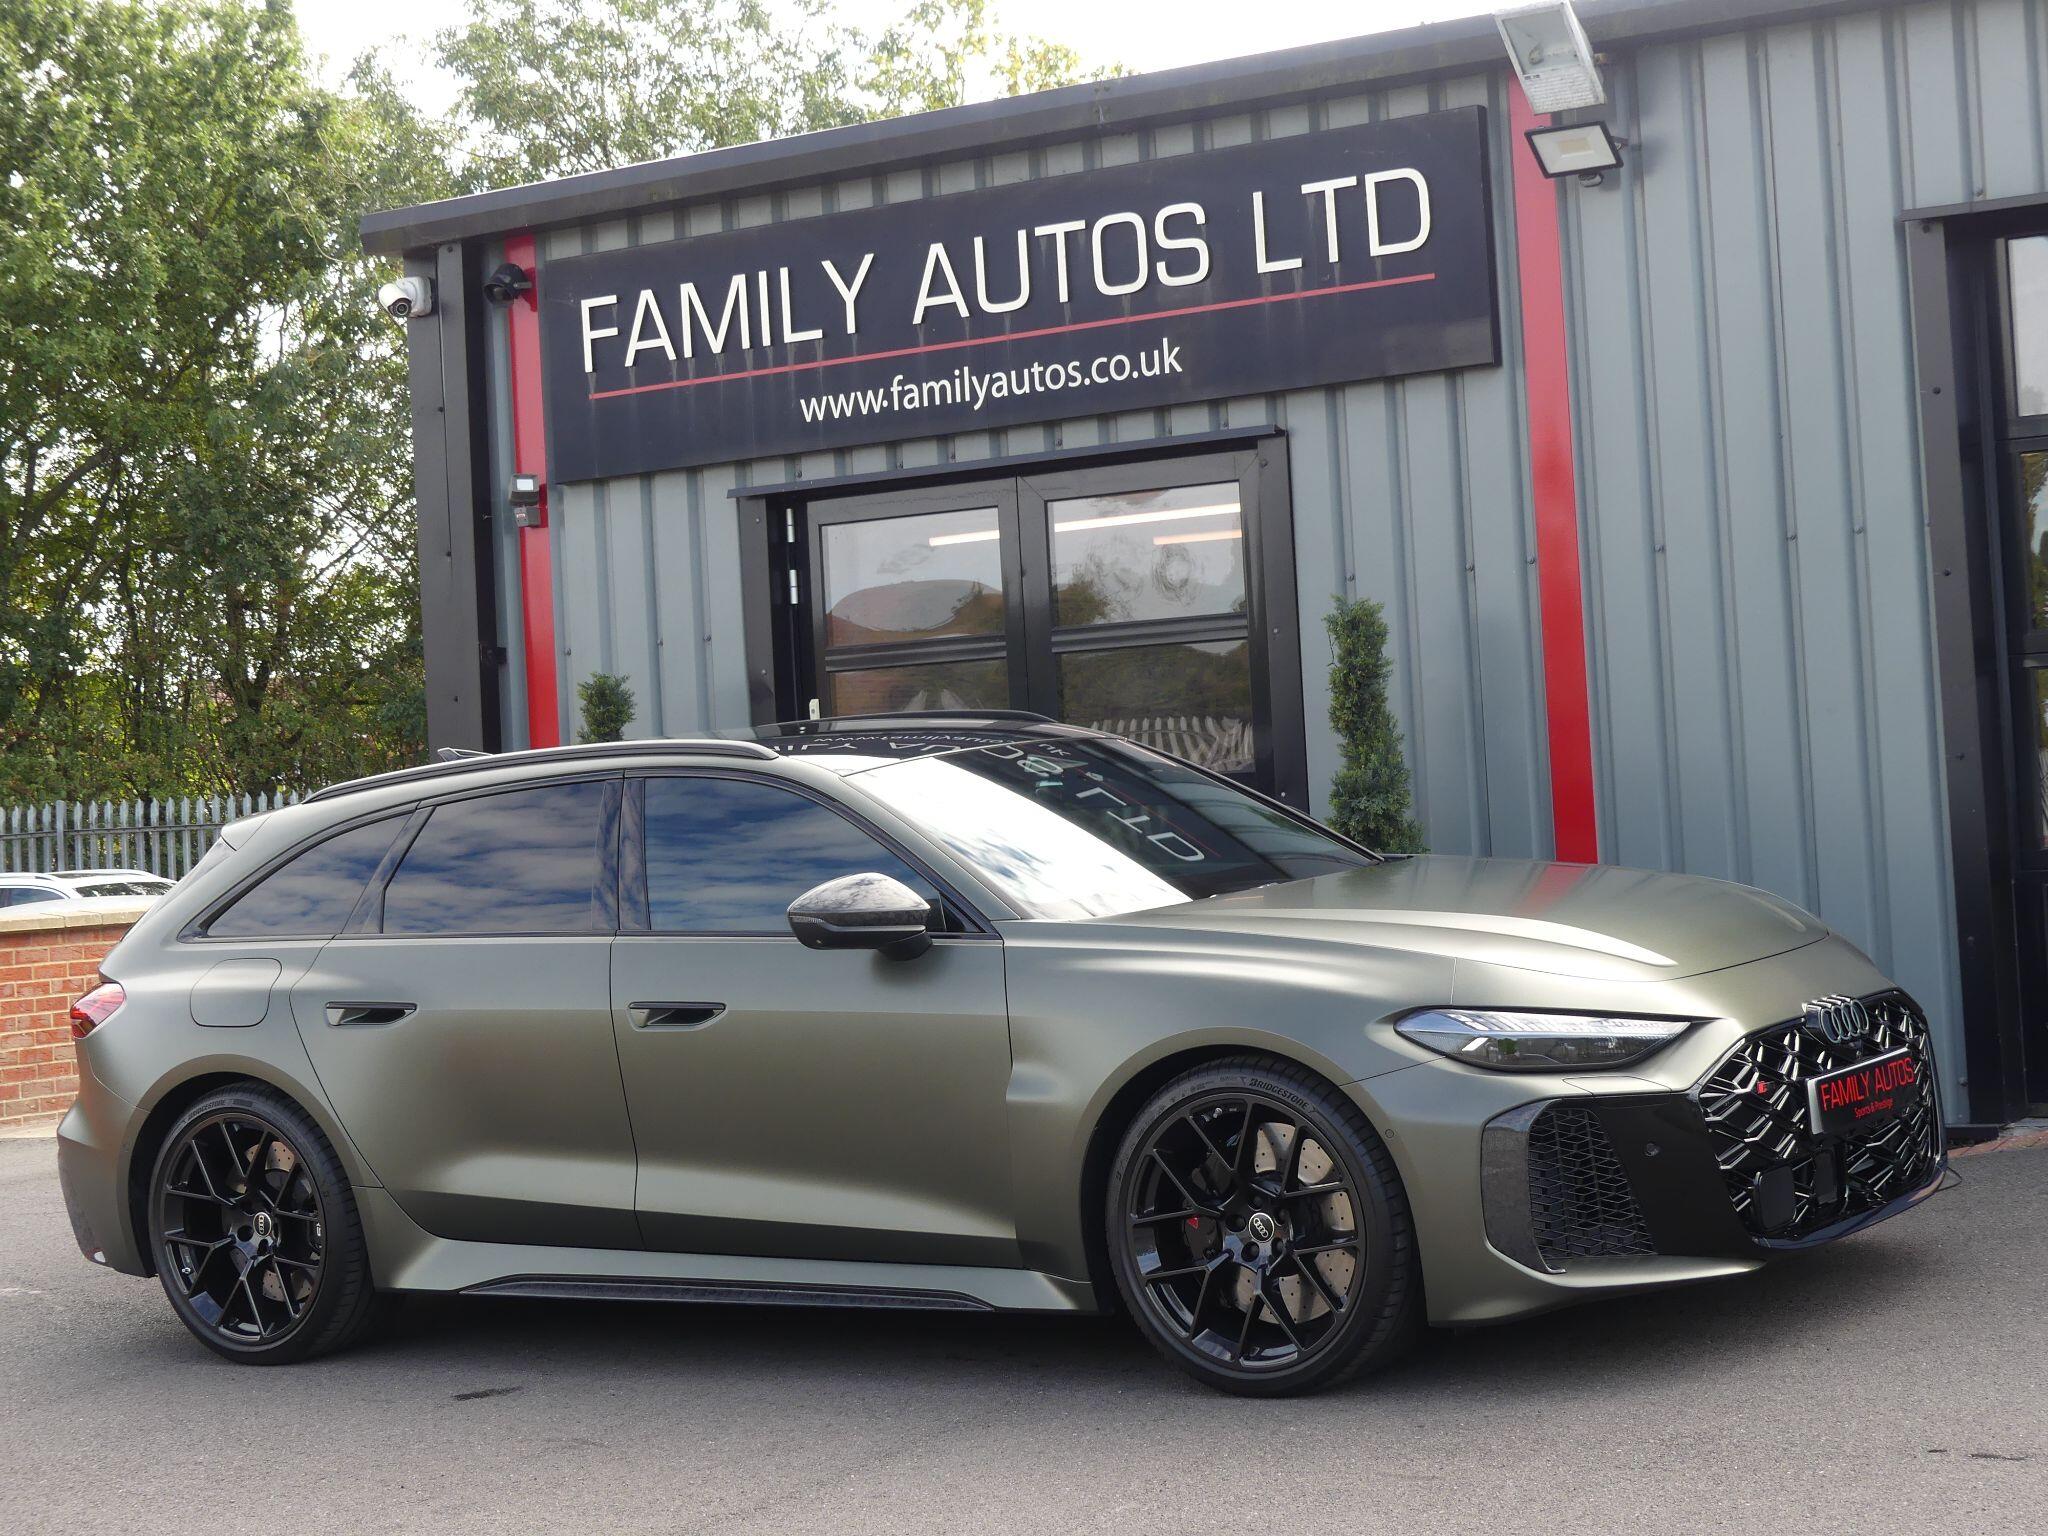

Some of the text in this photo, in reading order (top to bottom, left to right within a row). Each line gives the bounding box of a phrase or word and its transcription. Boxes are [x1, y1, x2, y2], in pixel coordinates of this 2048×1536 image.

[580, 167, 1432, 374] FAMILY AUTOS LTD
[799, 337, 1184, 423] www.familyautos.co.uk
[1248, 1078, 1310, 1110] BRIDGESTONE
[1820, 1058, 1915, 1111] FAMILY AUTOS
